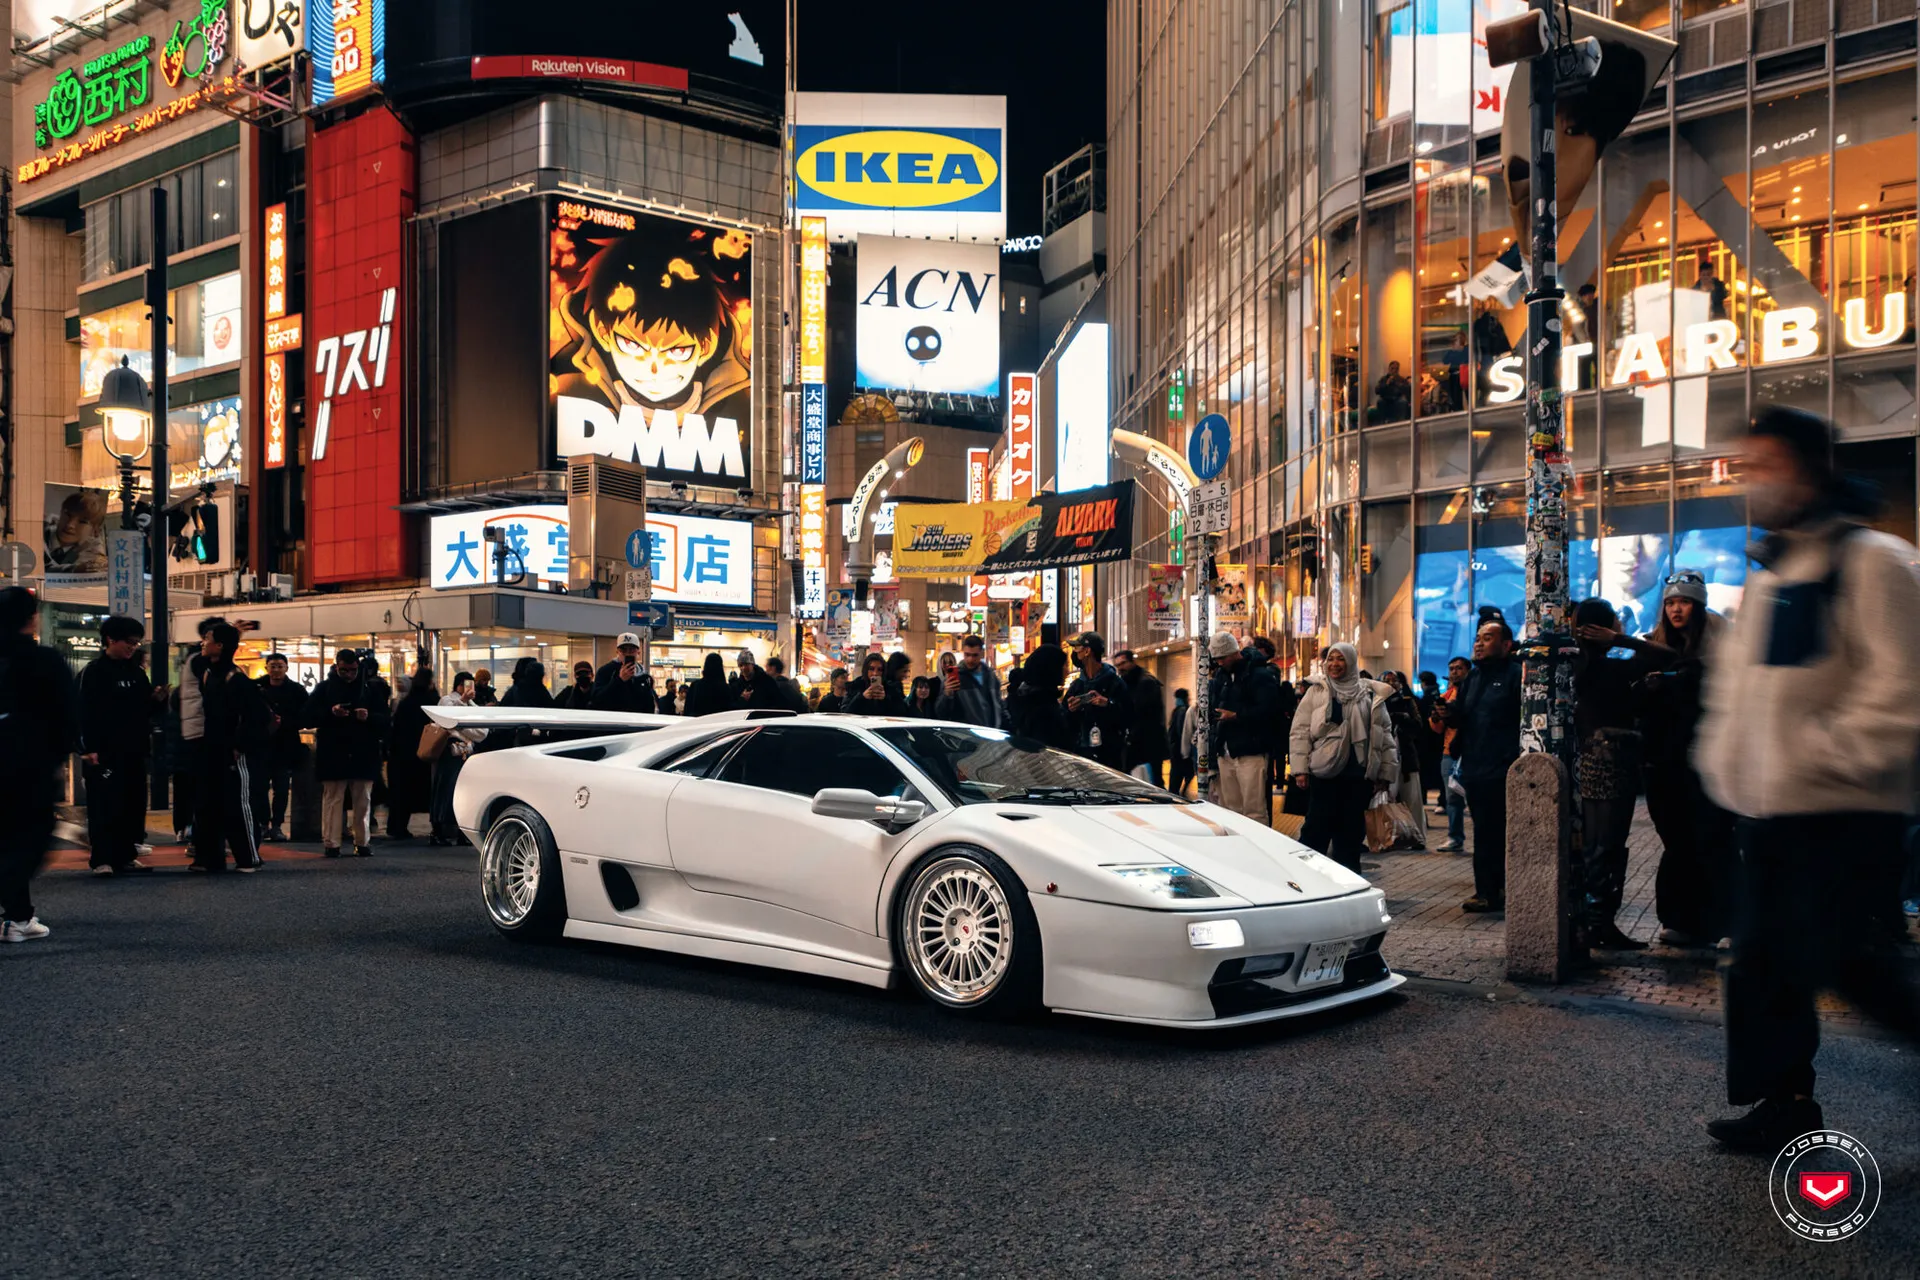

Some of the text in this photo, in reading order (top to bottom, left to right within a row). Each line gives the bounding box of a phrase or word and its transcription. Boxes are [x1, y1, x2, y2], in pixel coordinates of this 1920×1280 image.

[84, 55, 150, 126] 西村
[531, 59, 626, 76] Rakuten Vision
[815, 151, 984, 185] IKEA
[860, 265, 996, 314] ACN
[1488, 291, 1907, 404] STARBU
[557, 394, 746, 478] DMM
[806, 389, 822, 480] 大盛堂商事ビル
[1011, 387, 1032, 486] カラオケ
[1055, 498, 1118, 538] ALVARK
[1192, 489, 1201, 502] 15
[1220, 482, 1226, 496] 5
[1192, 519, 1201, 533] 12
[114, 538, 130, 614] 文化村通り
